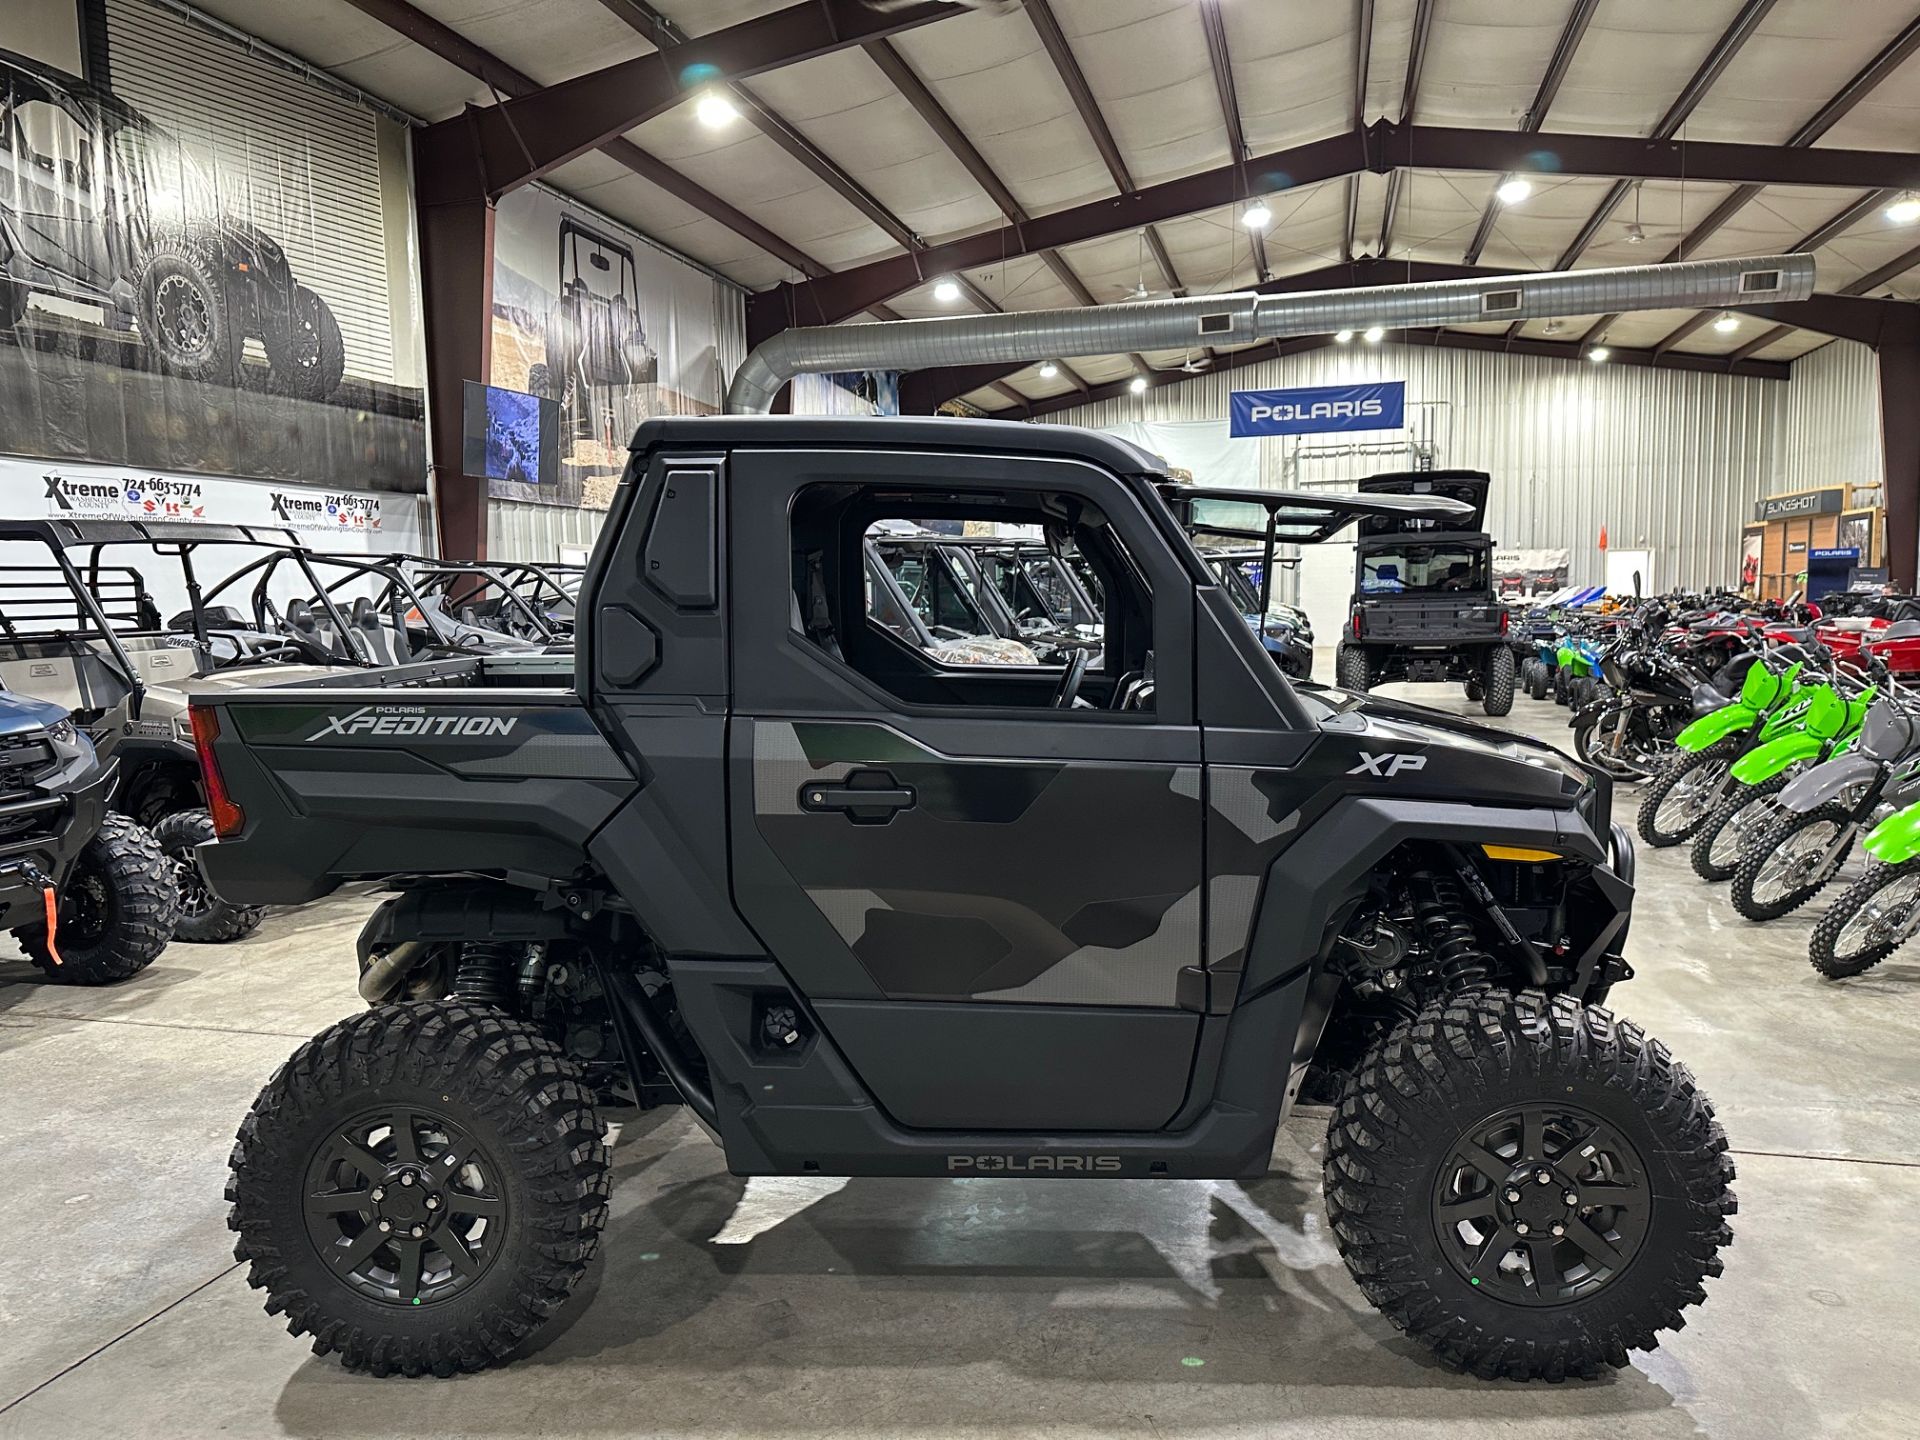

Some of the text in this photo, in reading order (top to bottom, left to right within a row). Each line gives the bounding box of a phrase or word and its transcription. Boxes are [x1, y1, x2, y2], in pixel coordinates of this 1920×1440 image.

[1251, 400, 1383, 423] POLARIS
[42, 476, 119, 510] Xtreme
[122, 477, 202, 498] 724-663-5774
[270, 493, 322, 521] Xtreme
[325, 494, 380, 511] 724-663-5774
[1767, 495, 1816, 514] SLINGSHOT
[376, 706, 426, 714] POLARIS
[304, 707, 518, 742] XPEDITION
[1345, 751, 1427, 777] XP
[947, 1155, 1122, 1171] POLARIS
